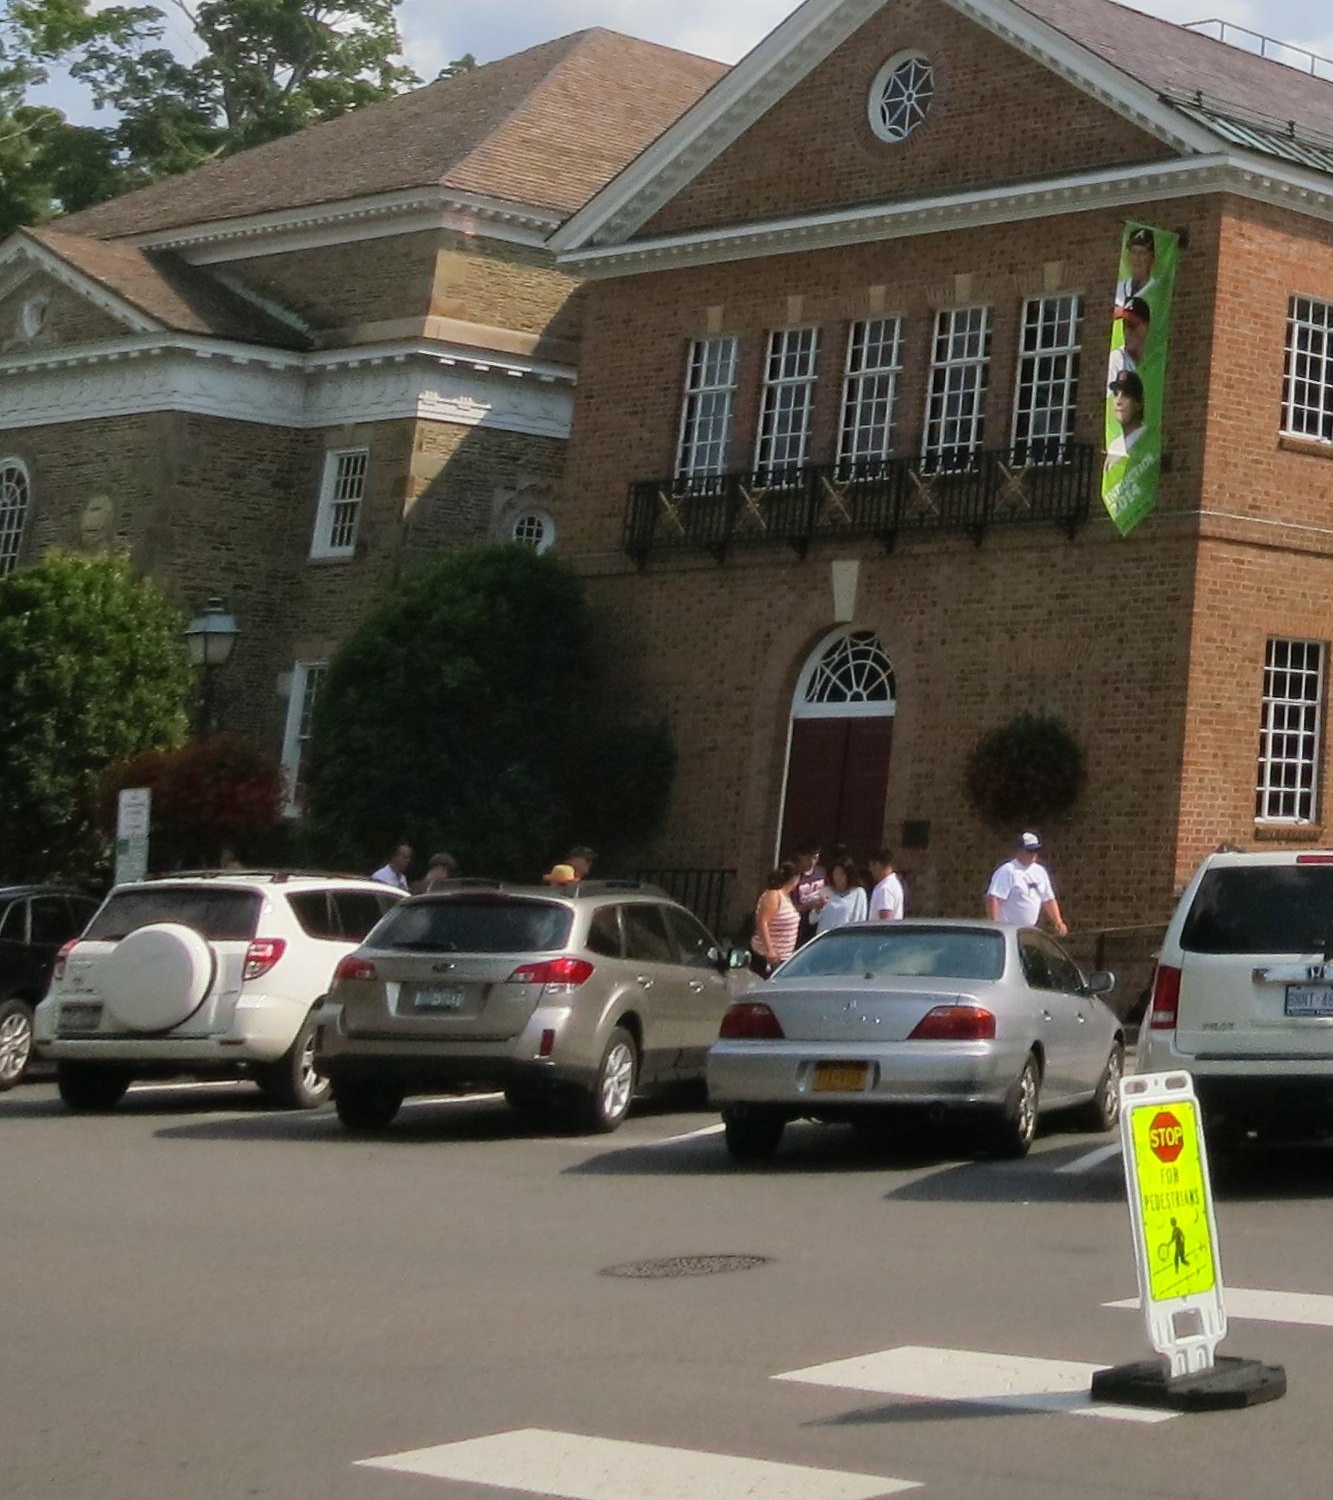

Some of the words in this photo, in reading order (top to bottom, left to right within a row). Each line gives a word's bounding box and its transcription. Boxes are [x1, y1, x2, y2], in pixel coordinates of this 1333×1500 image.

[1151, 1126, 1182, 1148] STOP
[1160, 1166, 1179, 1185] FOR
[1144, 1187, 1200, 1212] PEDESTRIANS
